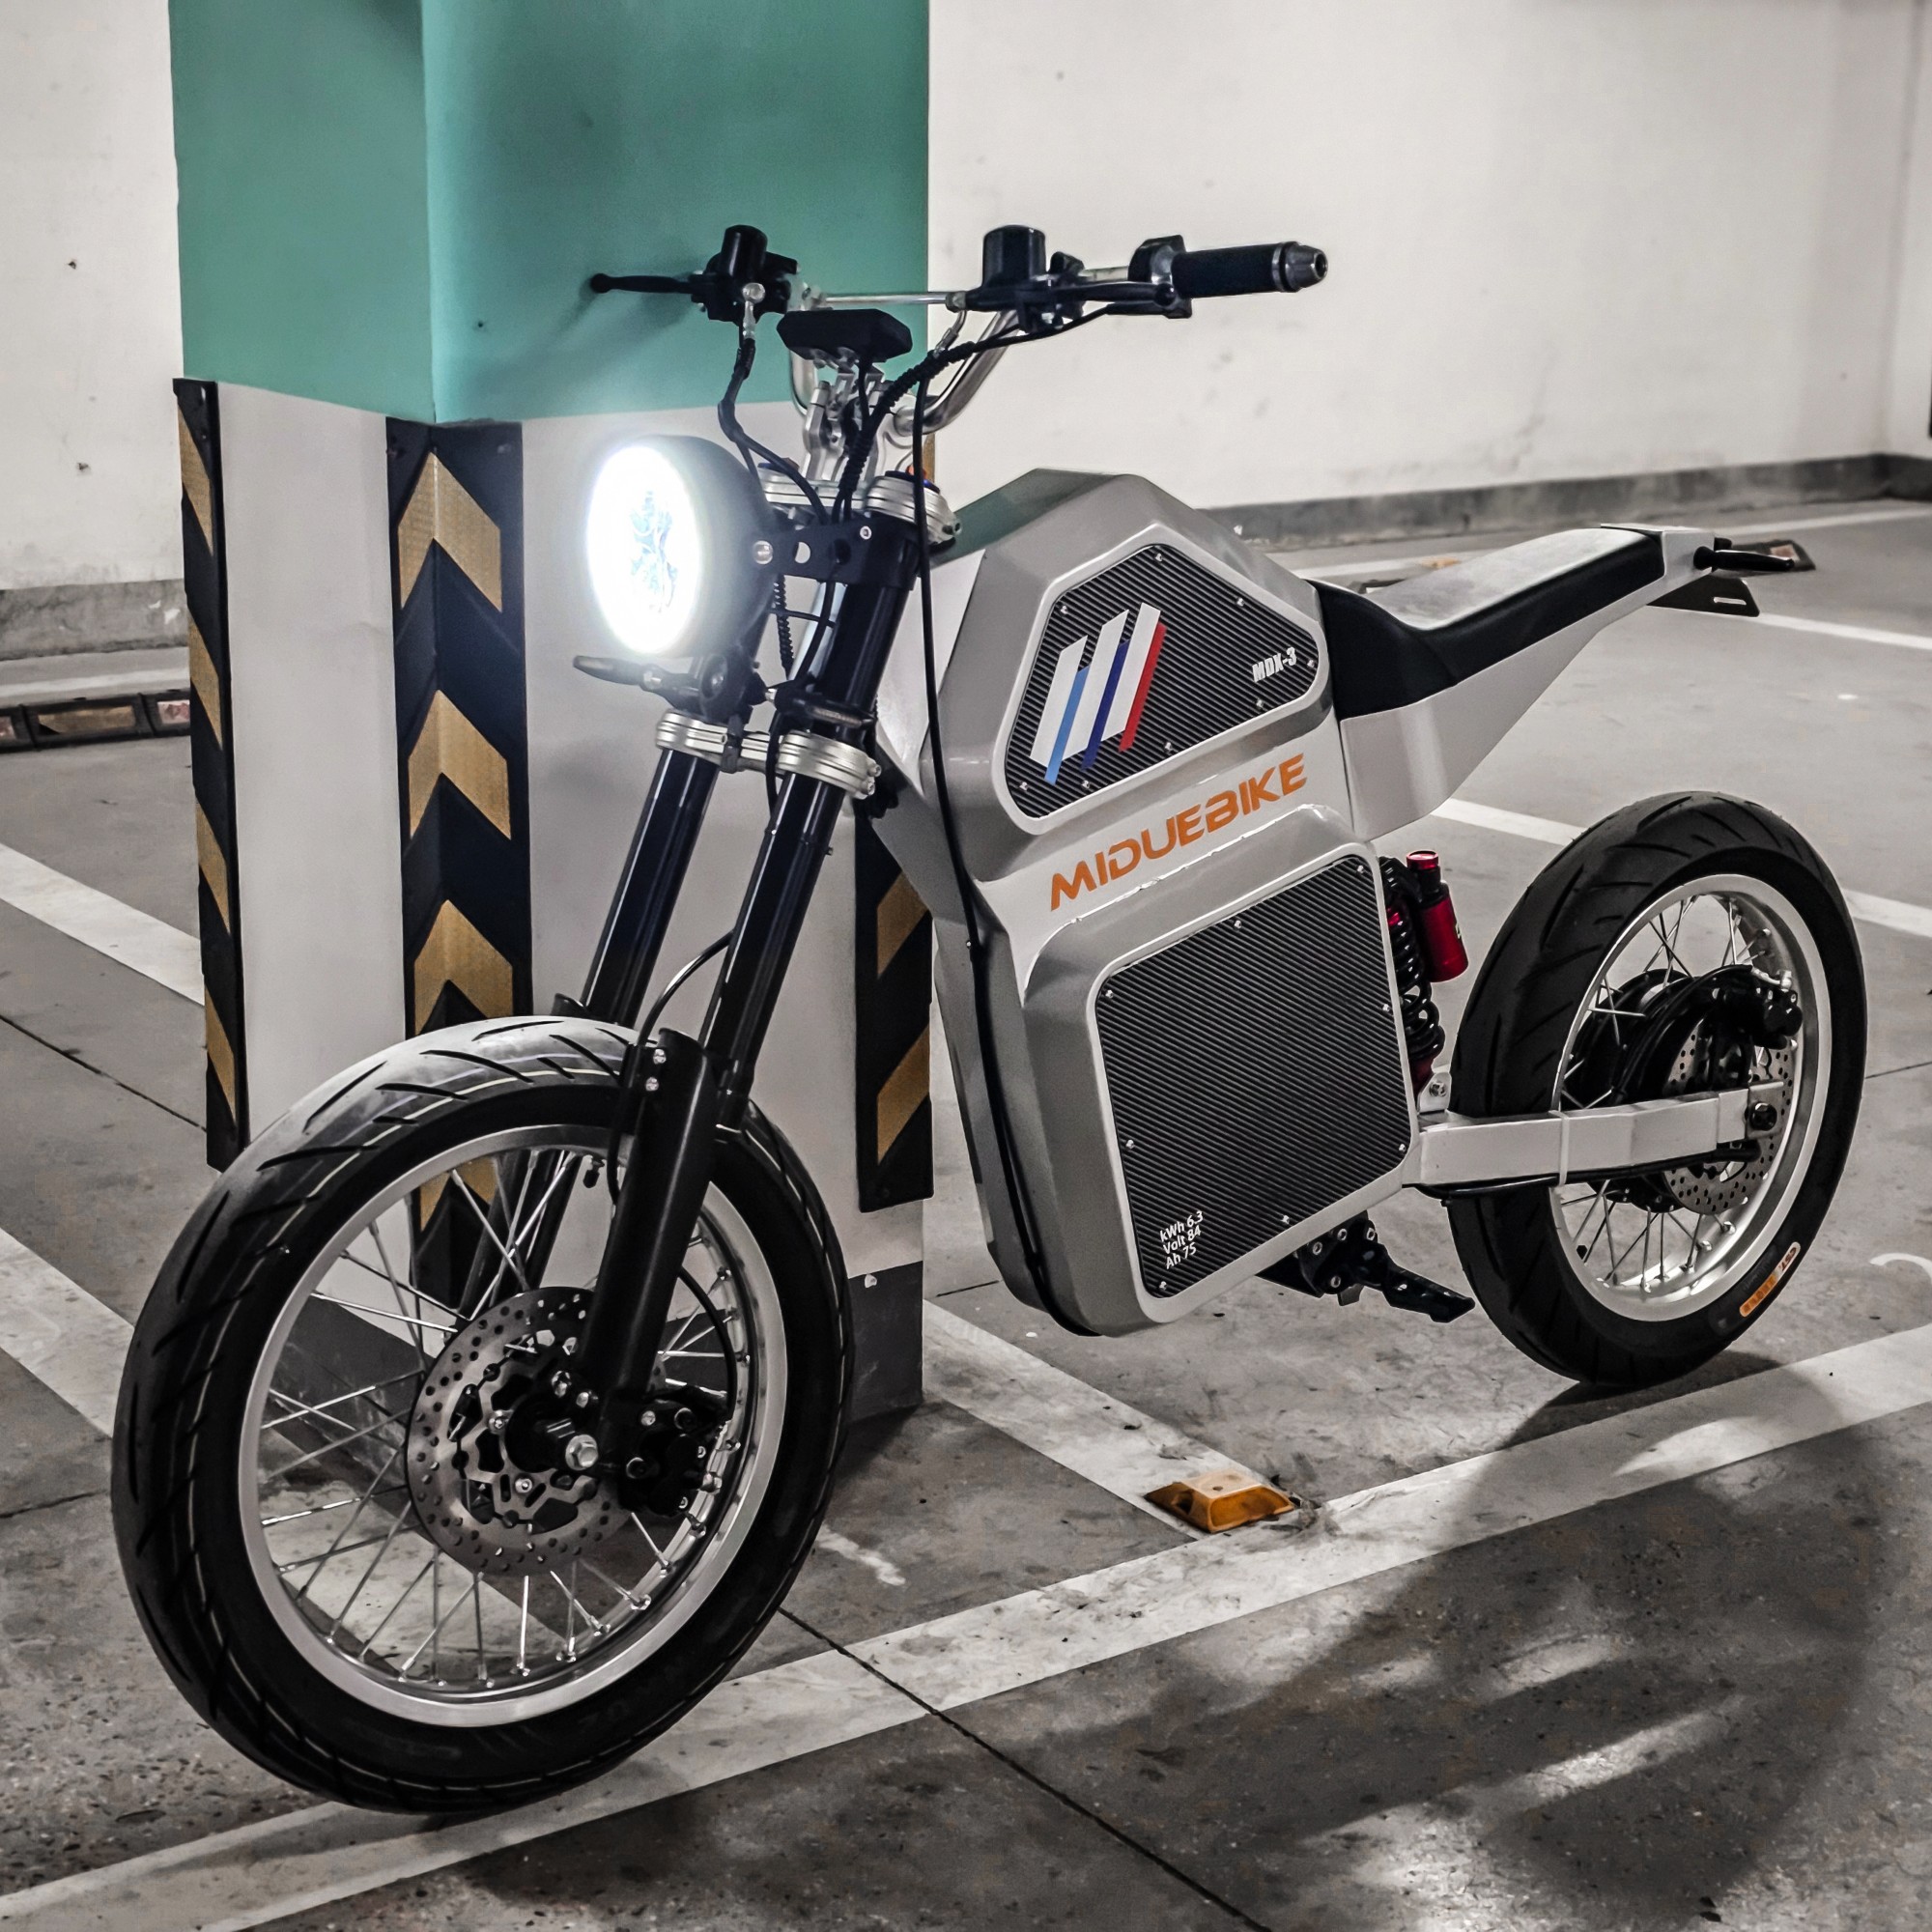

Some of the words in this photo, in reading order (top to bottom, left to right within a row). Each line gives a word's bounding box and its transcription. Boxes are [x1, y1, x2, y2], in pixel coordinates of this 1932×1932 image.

[1252, 646, 1297, 683] MDX-3
[1050, 753, 1307, 911] MIDUEBIKE
[1160, 1221, 1185, 1242] kWh
[1163, 1235, 1185, 1254] Volt
[1187, 1225, 1202, 1241] 84
[1166, 1253, 1181, 1269] Ah
[1183, 1242, 1197, 1259] 75
